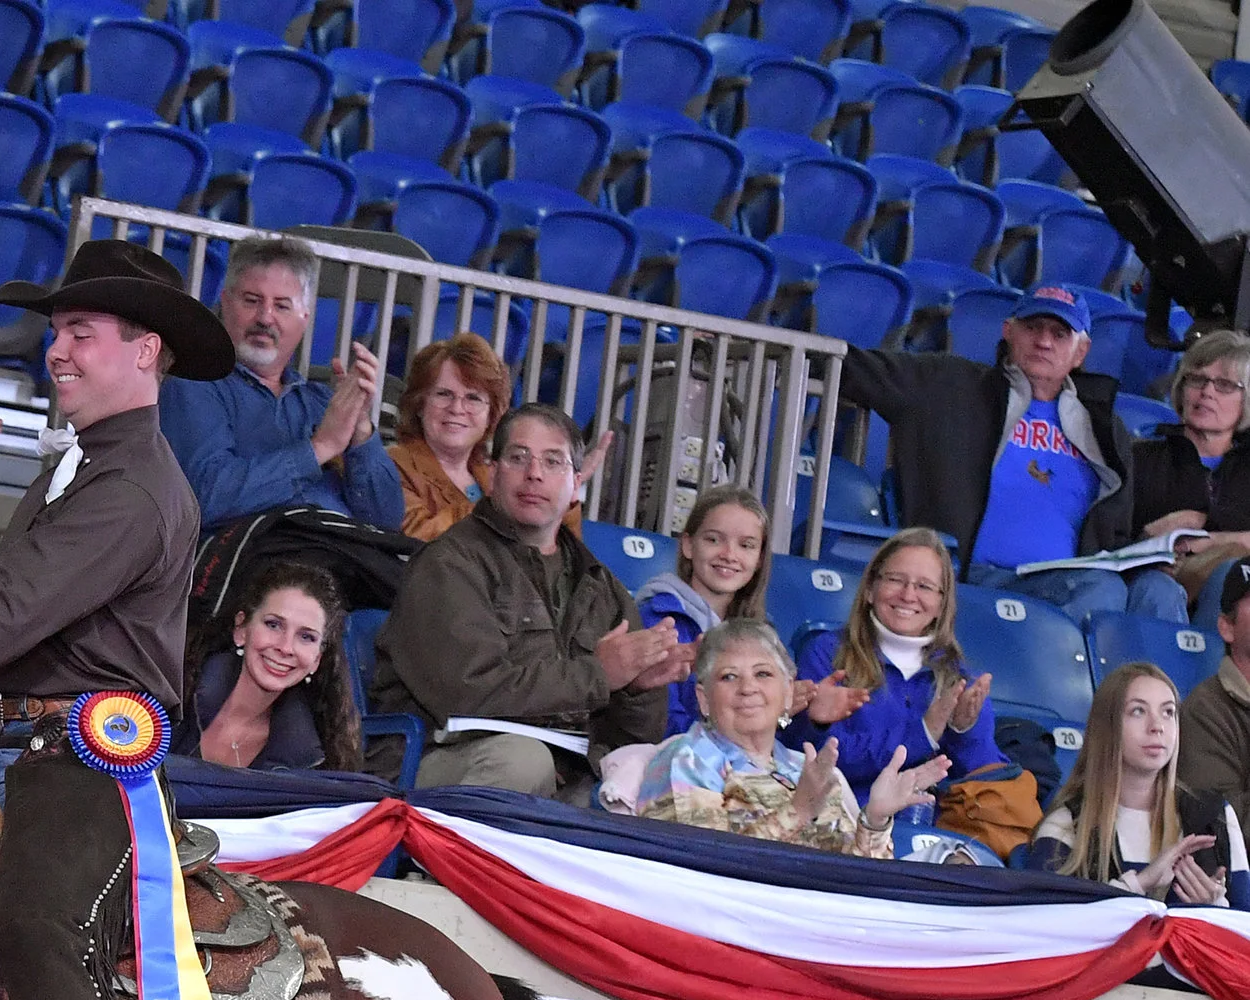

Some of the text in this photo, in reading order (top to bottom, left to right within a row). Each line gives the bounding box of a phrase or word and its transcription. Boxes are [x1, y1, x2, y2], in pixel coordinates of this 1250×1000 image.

[1011, 418, 1083, 460] ARK
[631, 540, 646, 554] 19
[820, 574, 835, 588] 20
[1004, 603, 1018, 618] 21
[1184, 634, 1199, 649] 22
[1062, 731, 1078, 747] 20
